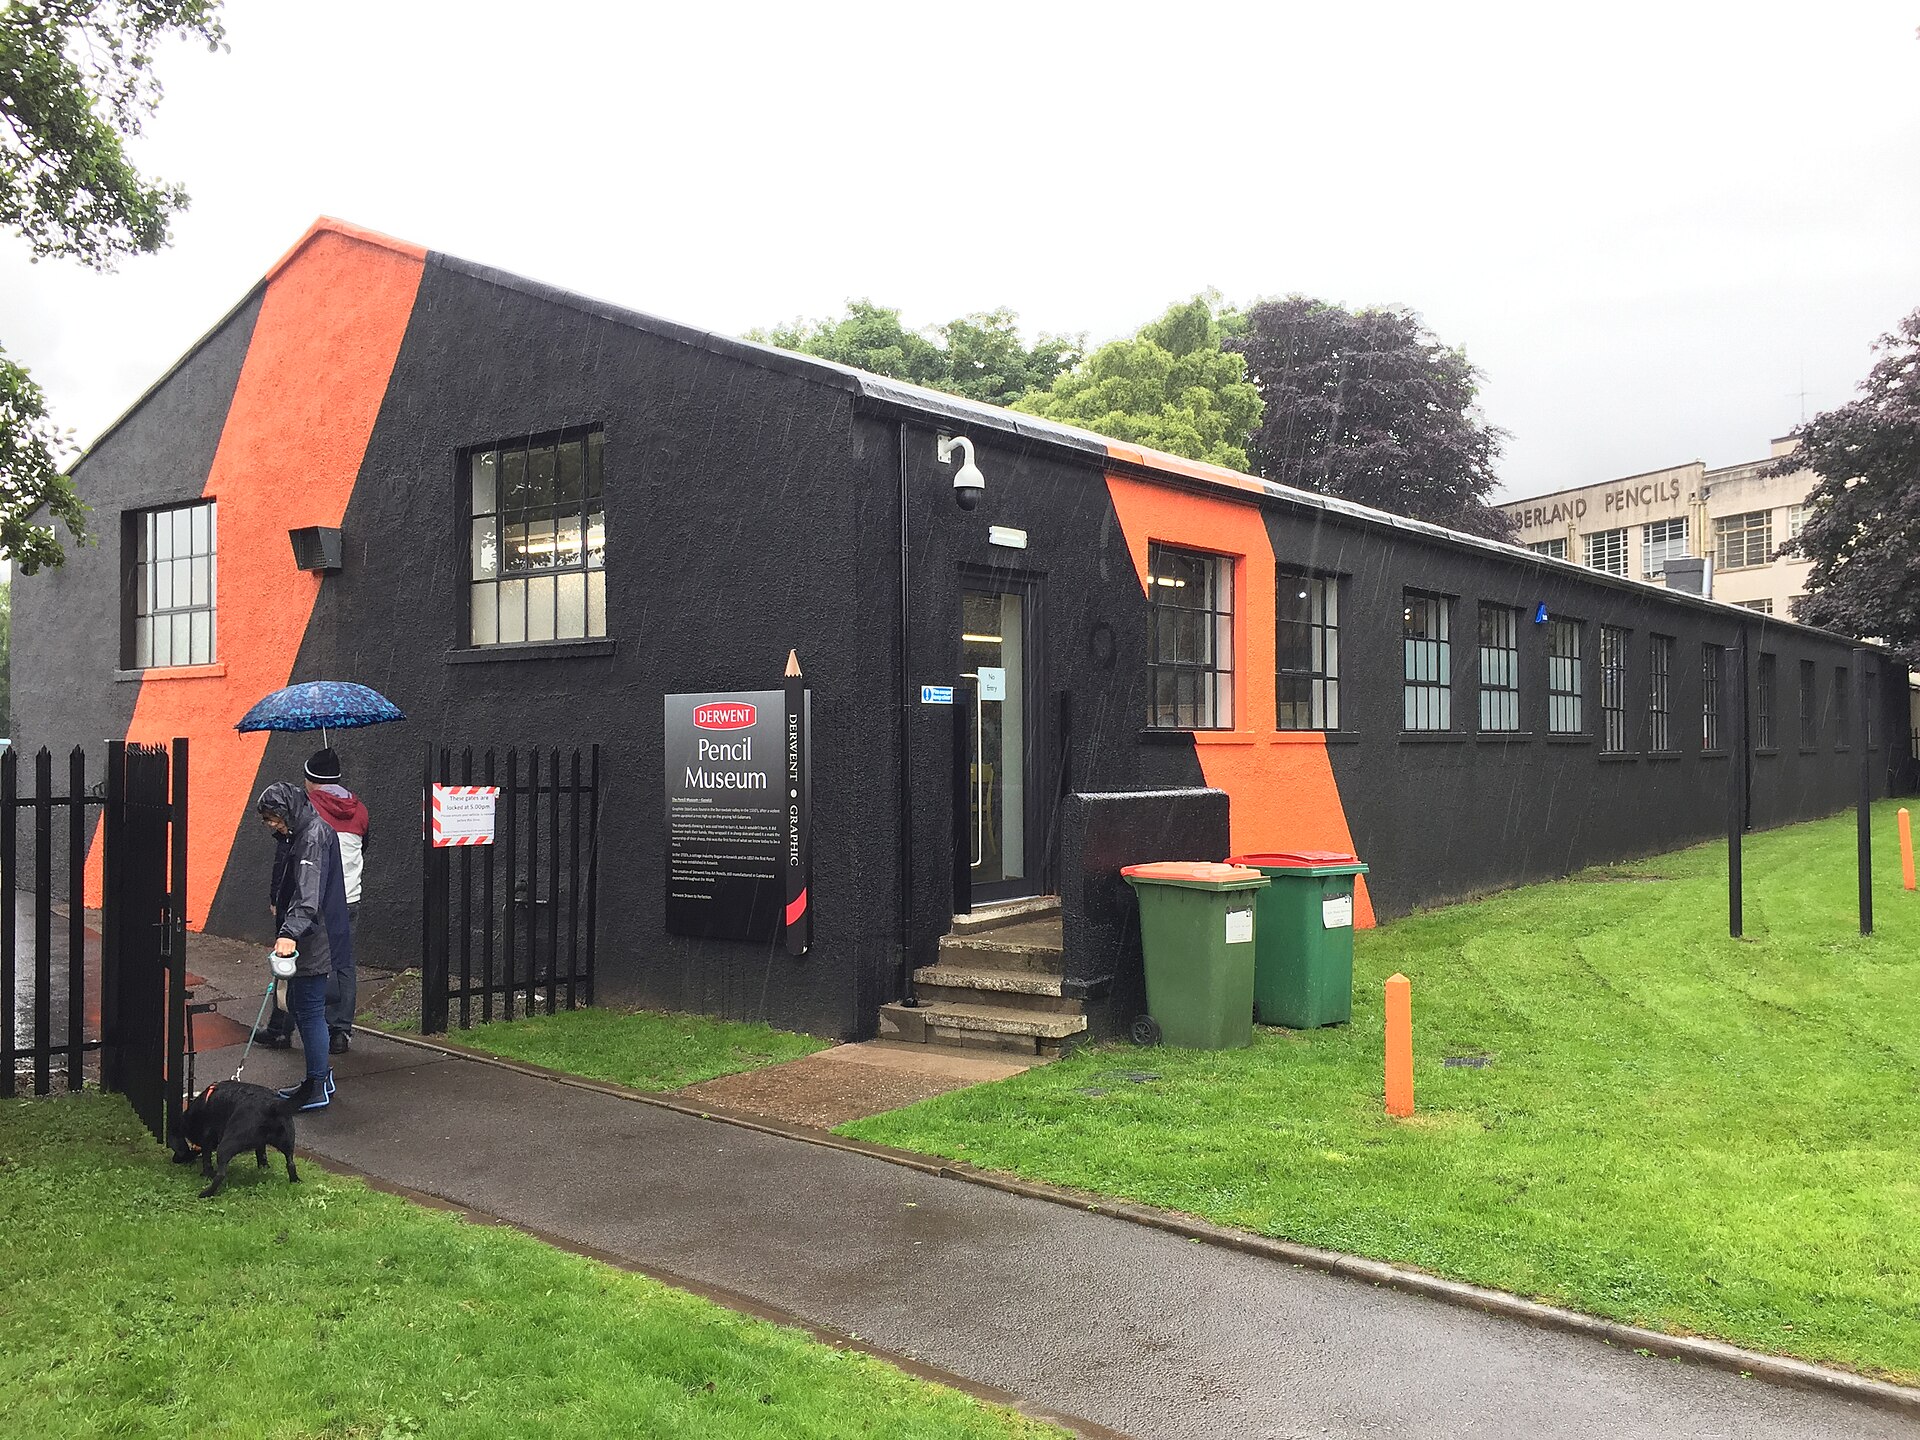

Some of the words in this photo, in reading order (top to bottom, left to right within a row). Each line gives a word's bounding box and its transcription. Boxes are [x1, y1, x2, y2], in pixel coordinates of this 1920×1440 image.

[1604, 478, 1681, 513] PENCILS
[699, 709, 751, 725] DERWENT
[698, 737, 752, 761] Pencil
[789, 713, 798, 783] DERWENT
[685, 766, 768, 790] Museum
[789, 804, 800, 867] GRAPHIC
